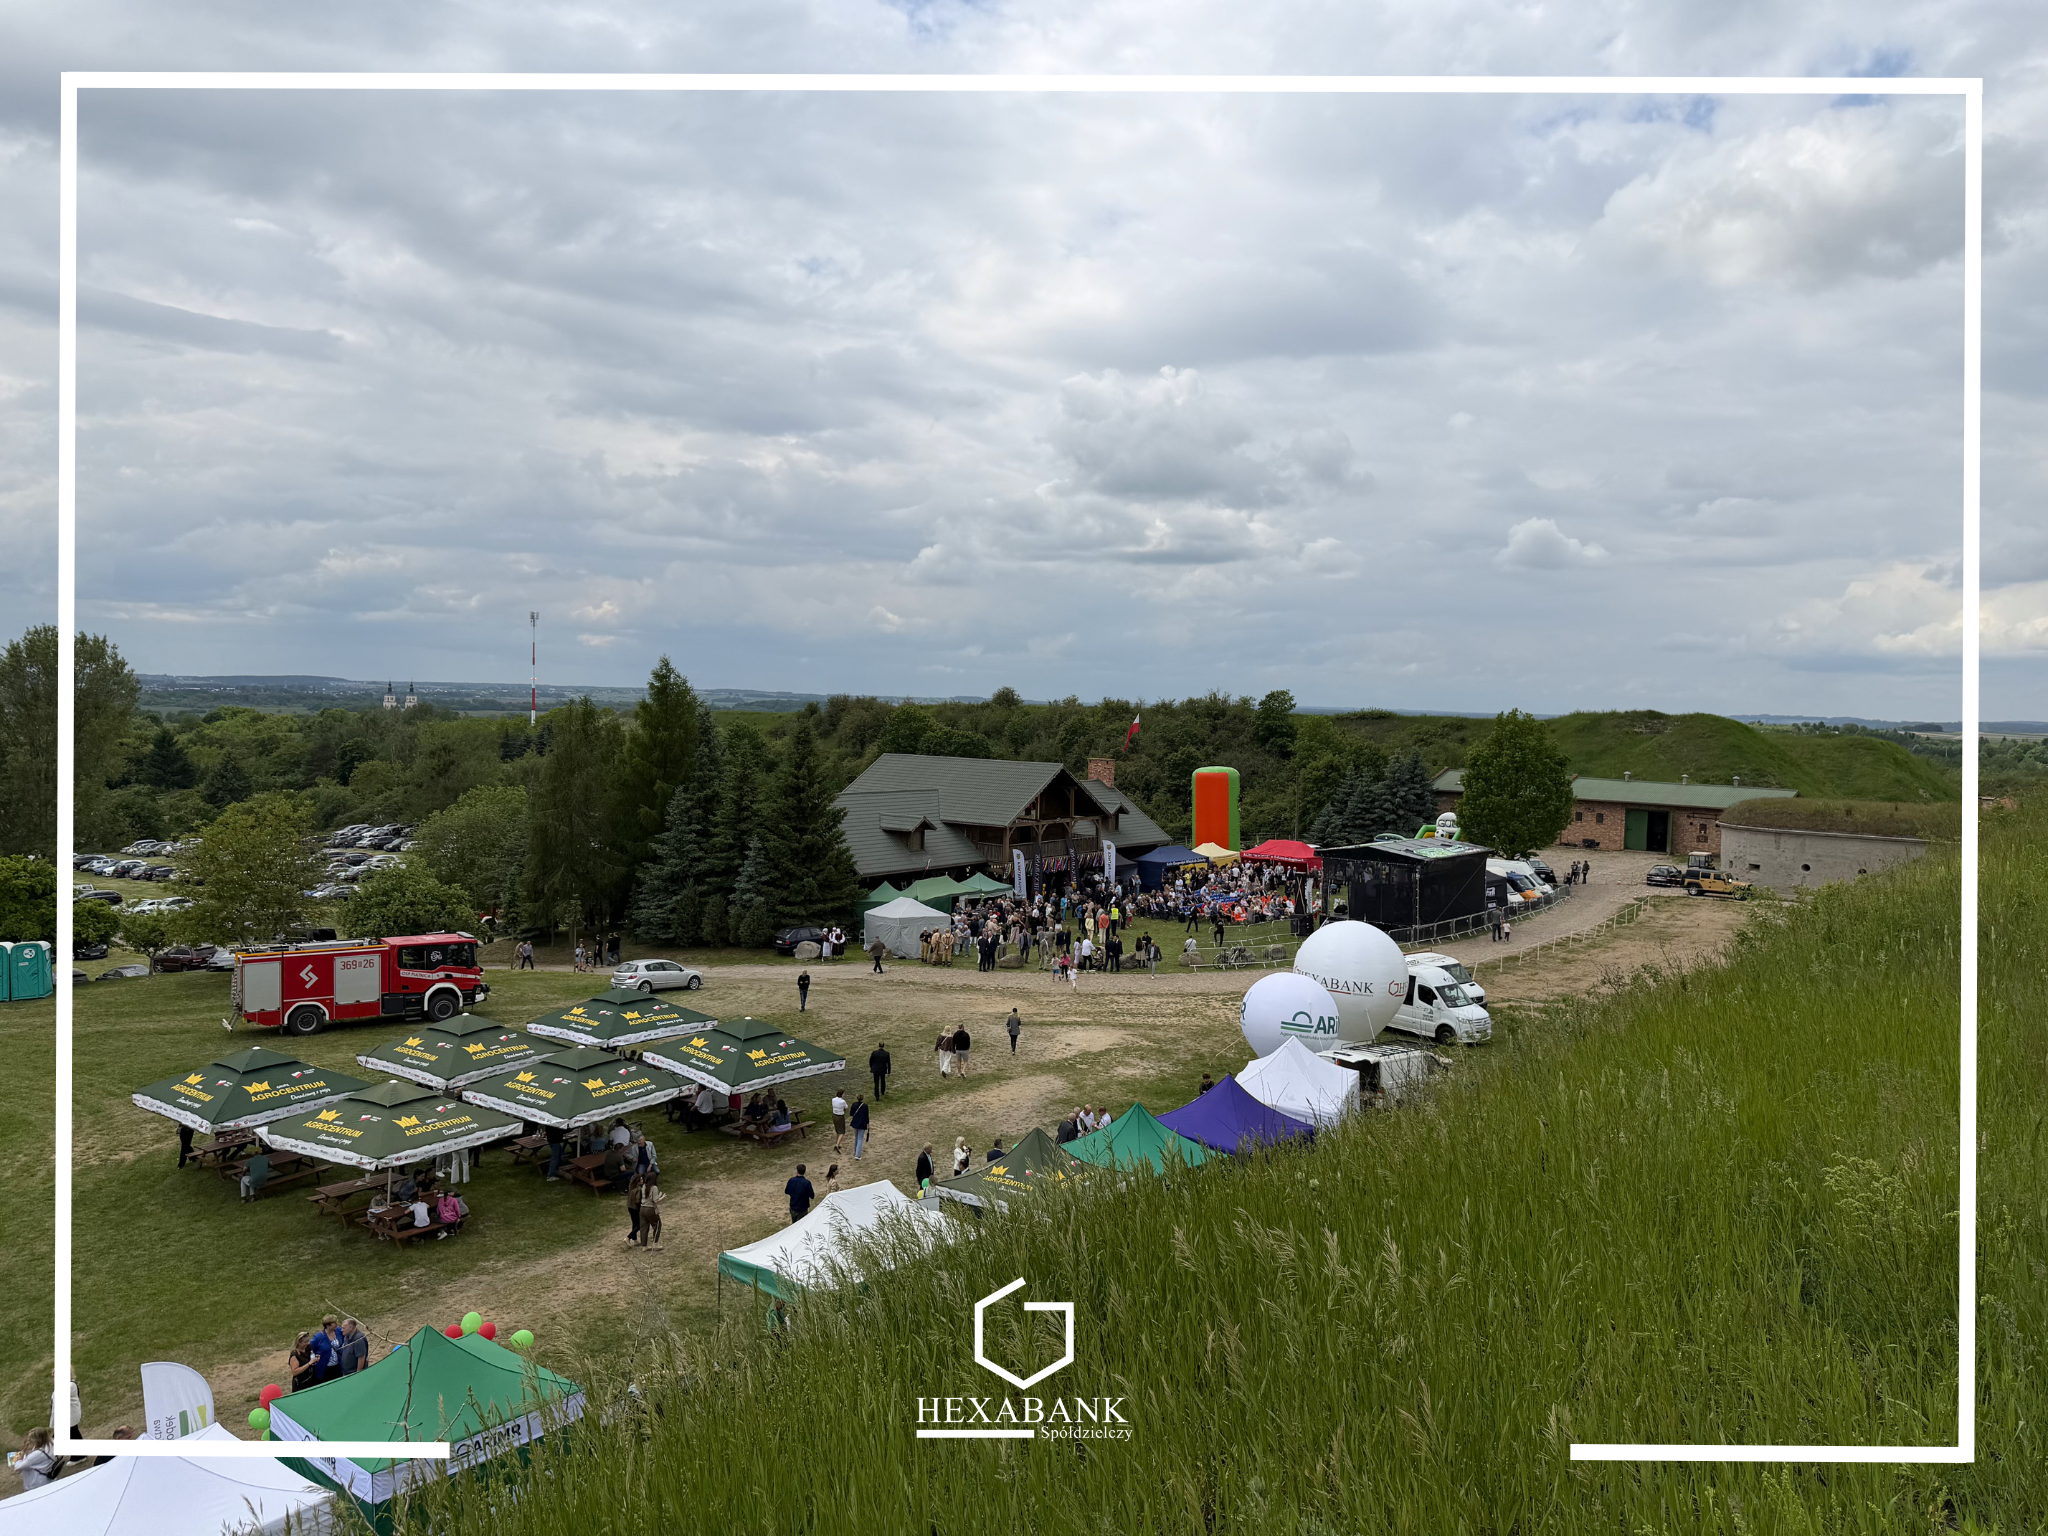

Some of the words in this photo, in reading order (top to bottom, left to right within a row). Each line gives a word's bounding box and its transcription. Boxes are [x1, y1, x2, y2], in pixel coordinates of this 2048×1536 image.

[1314, 1016, 1340, 1034] ARi
[393, 1046, 438, 1062] AGROCENTRUM
[472, 1044, 530, 1060] AGROCENTRUM
[679, 1046, 724, 1065] AGROCENTRUM
[754, 1051, 806, 1068] AGROCENTRUM
[170, 1084, 214, 1102] AGROCENTRUM
[251, 1080, 326, 1102] AGROCENTRUM
[504, 1081, 556, 1099] AGROCENTRUM
[591, 1078, 651, 1098] AGROCENTRUM
[302, 1120, 364, 1138] AGROCENTRUM
[404, 1116, 472, 1136] AGROCENTRUM
